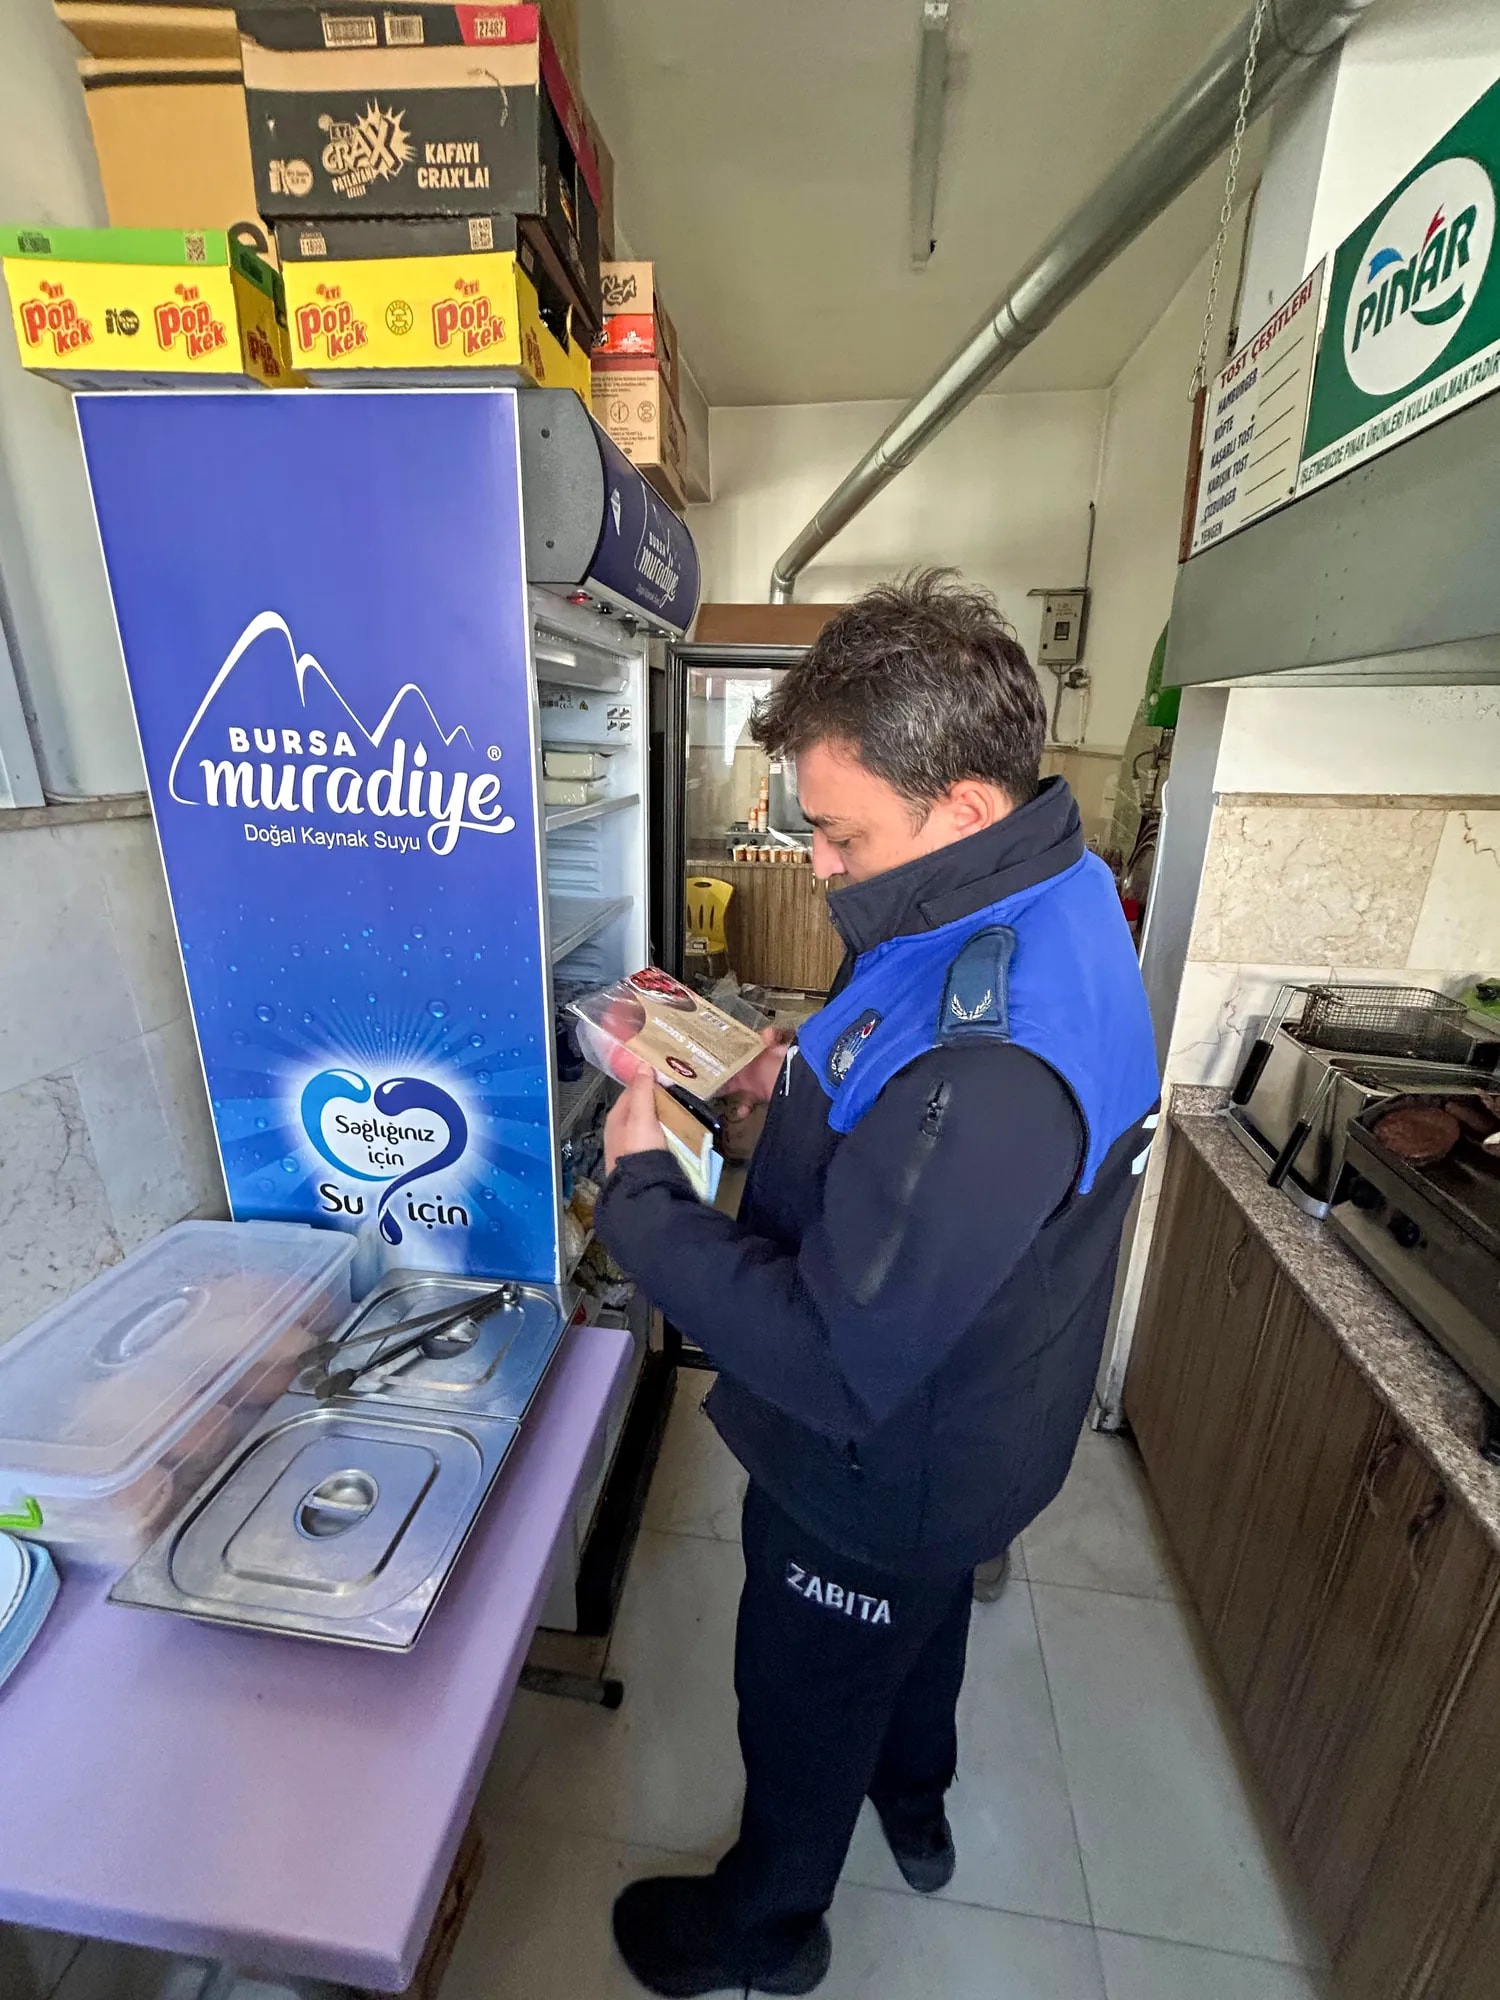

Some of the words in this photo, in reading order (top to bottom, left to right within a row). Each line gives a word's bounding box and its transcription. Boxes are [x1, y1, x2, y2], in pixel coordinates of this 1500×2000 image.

[322, 115, 402, 175] CRAX
[425, 141, 480, 164] KAFAYI
[1351, 203, 1477, 354] PINAR
[1220, 349, 1250, 389] TOST
[1251, 278, 1313, 363] ÇEŞİTLERİ
[1217, 367, 1258, 416] HAMBURGER
[1214, 414, 1235, 444] KÖFTE
[1238, 422, 1256, 449] TOST
[1344, 432, 1366, 460] PINAR
[1233, 453, 1250, 478] TOST
[228, 726, 357, 757] BURSA
[199, 738, 516, 856] muradiye
[245, 823, 296, 845] Doğal
[301, 825, 369, 850] Kaynak
[374, 830, 421, 853] Suyu
[334, 1114, 436, 1145] Sağlığınız
[367, 1145, 405, 1169] için
[319, 1183, 364, 1216] Su
[406, 1192, 469, 1230] için
[786, 1561, 892, 1625] ZABITA
